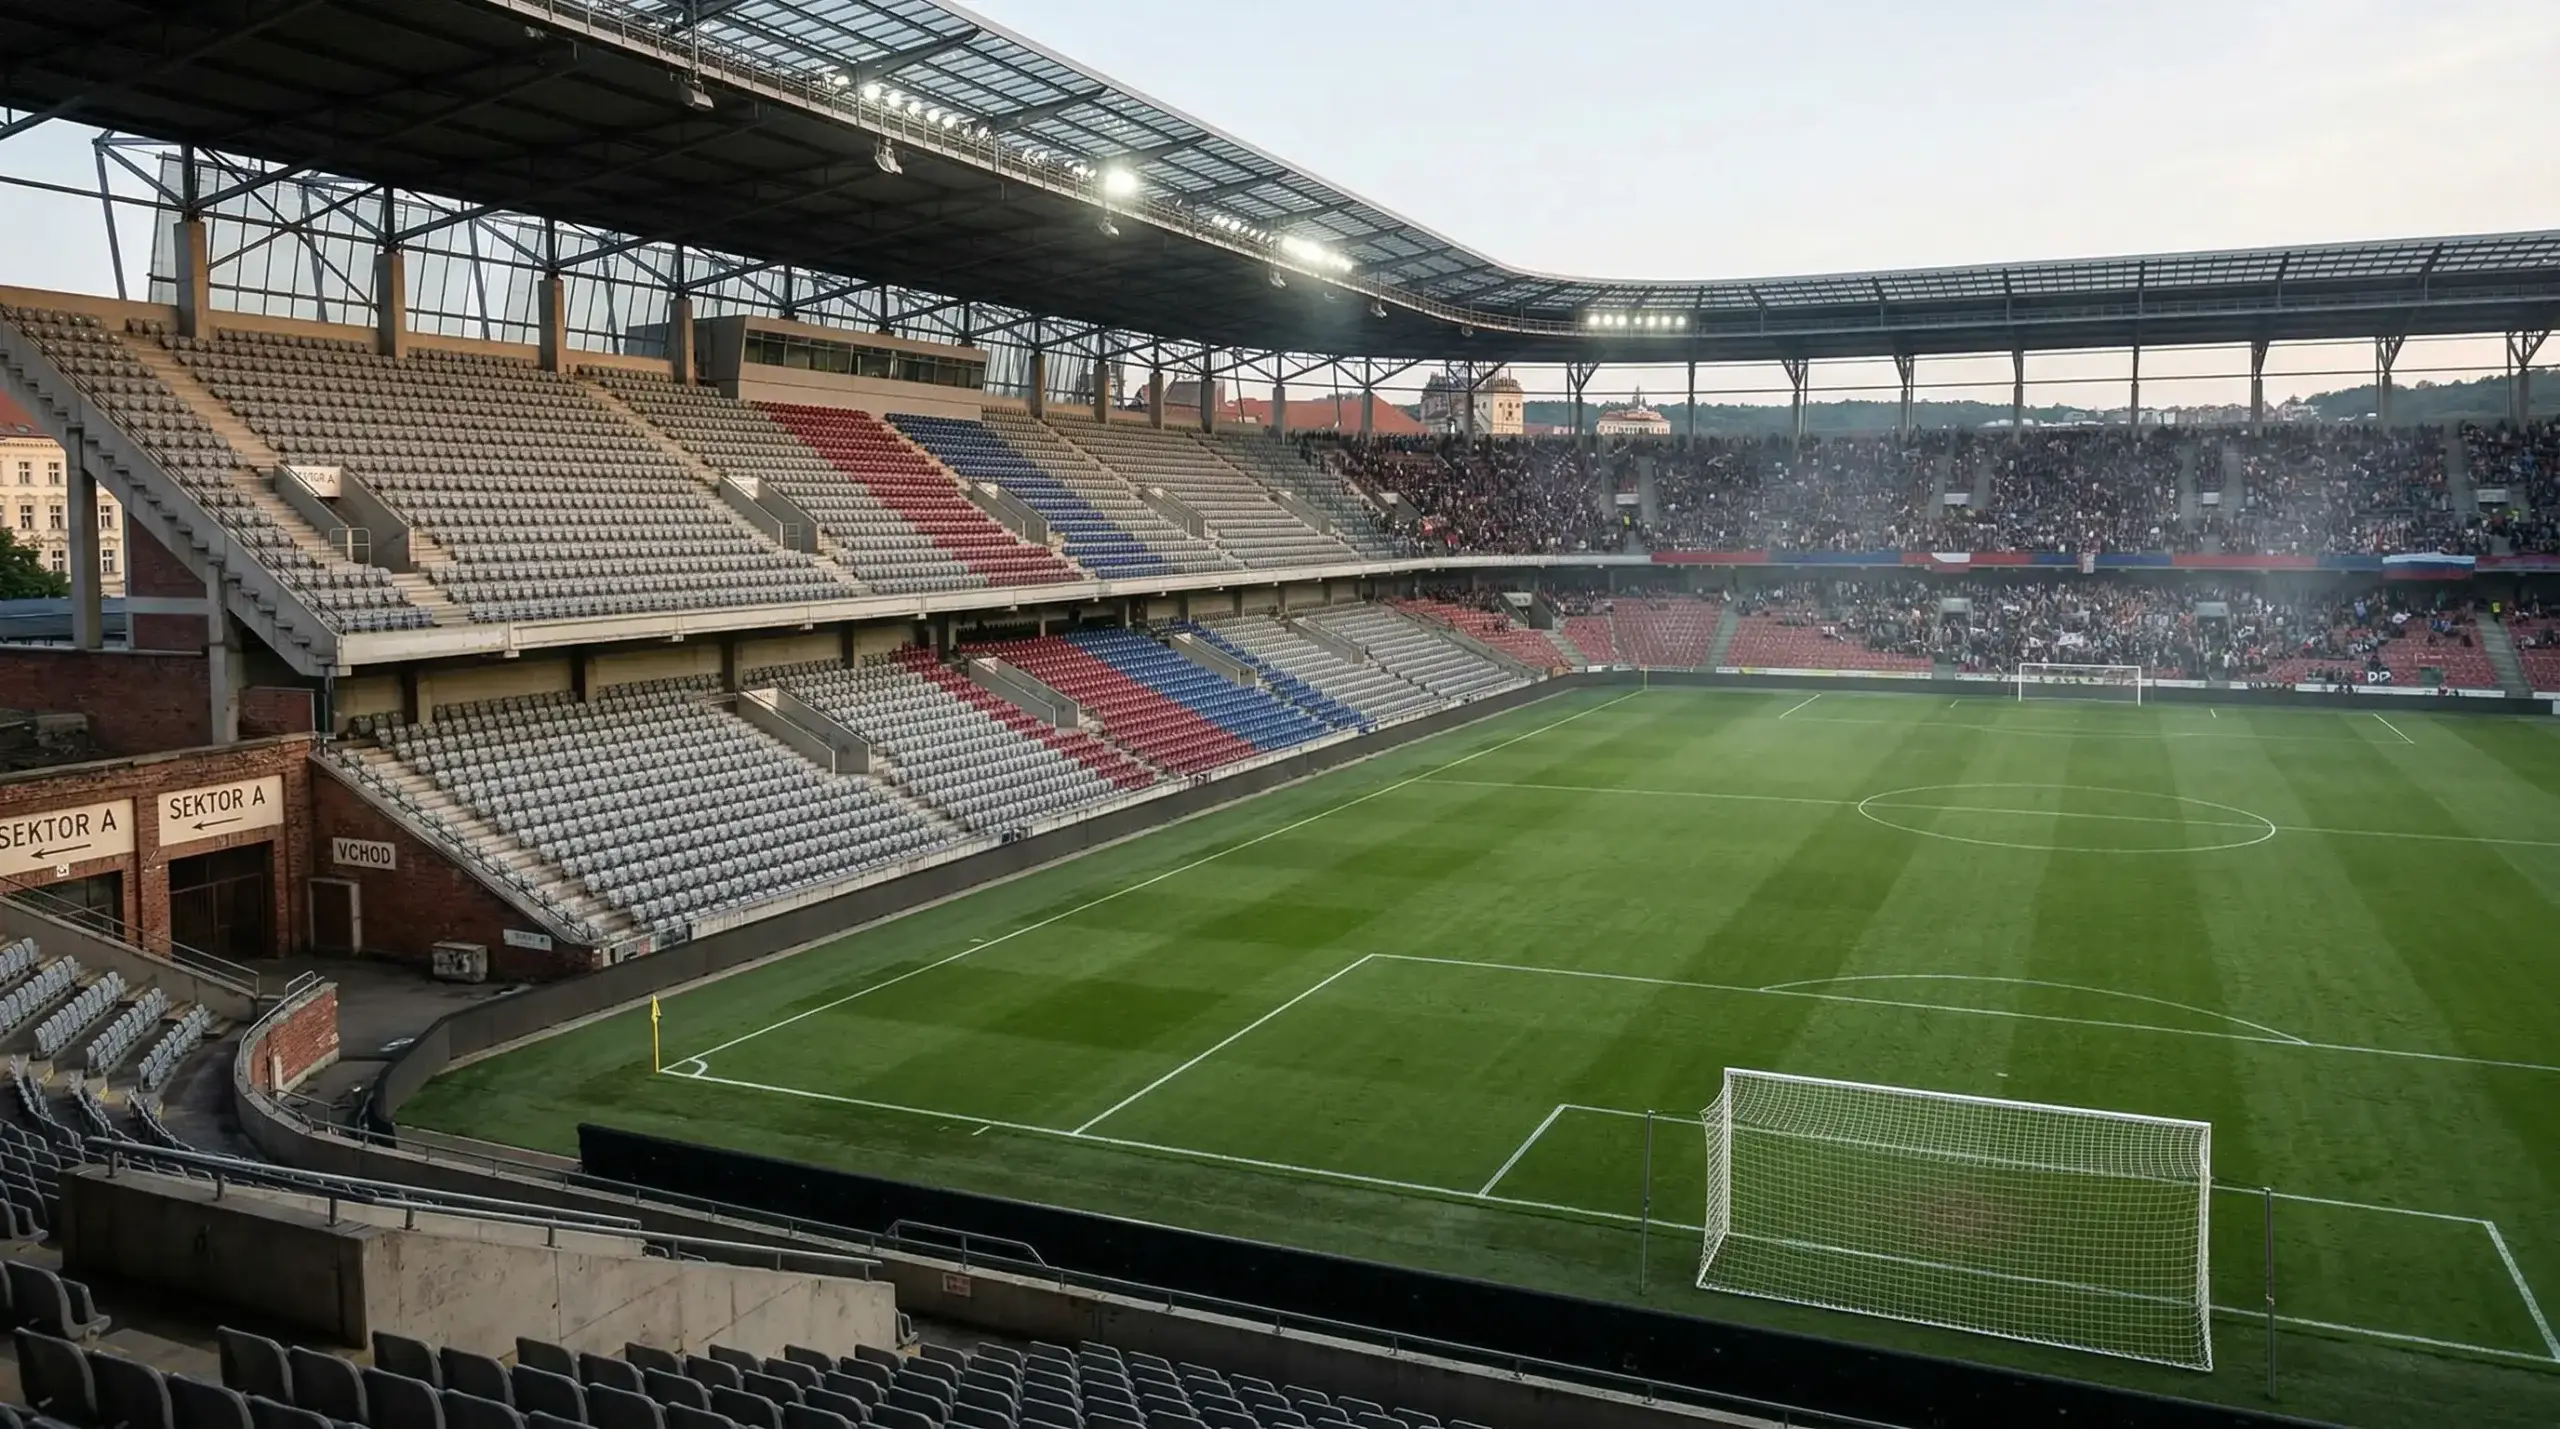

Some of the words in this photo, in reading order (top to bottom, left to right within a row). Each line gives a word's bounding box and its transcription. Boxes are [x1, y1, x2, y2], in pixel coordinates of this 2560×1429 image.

[327, 475, 335, 484] A
[170, 788, 244, 820] SEKTOR
[252, 785, 266, 806] A
[0, 813, 90, 850] SEKTOR
[101, 809, 117, 832] A
[338, 841, 391, 865] VCHOD
